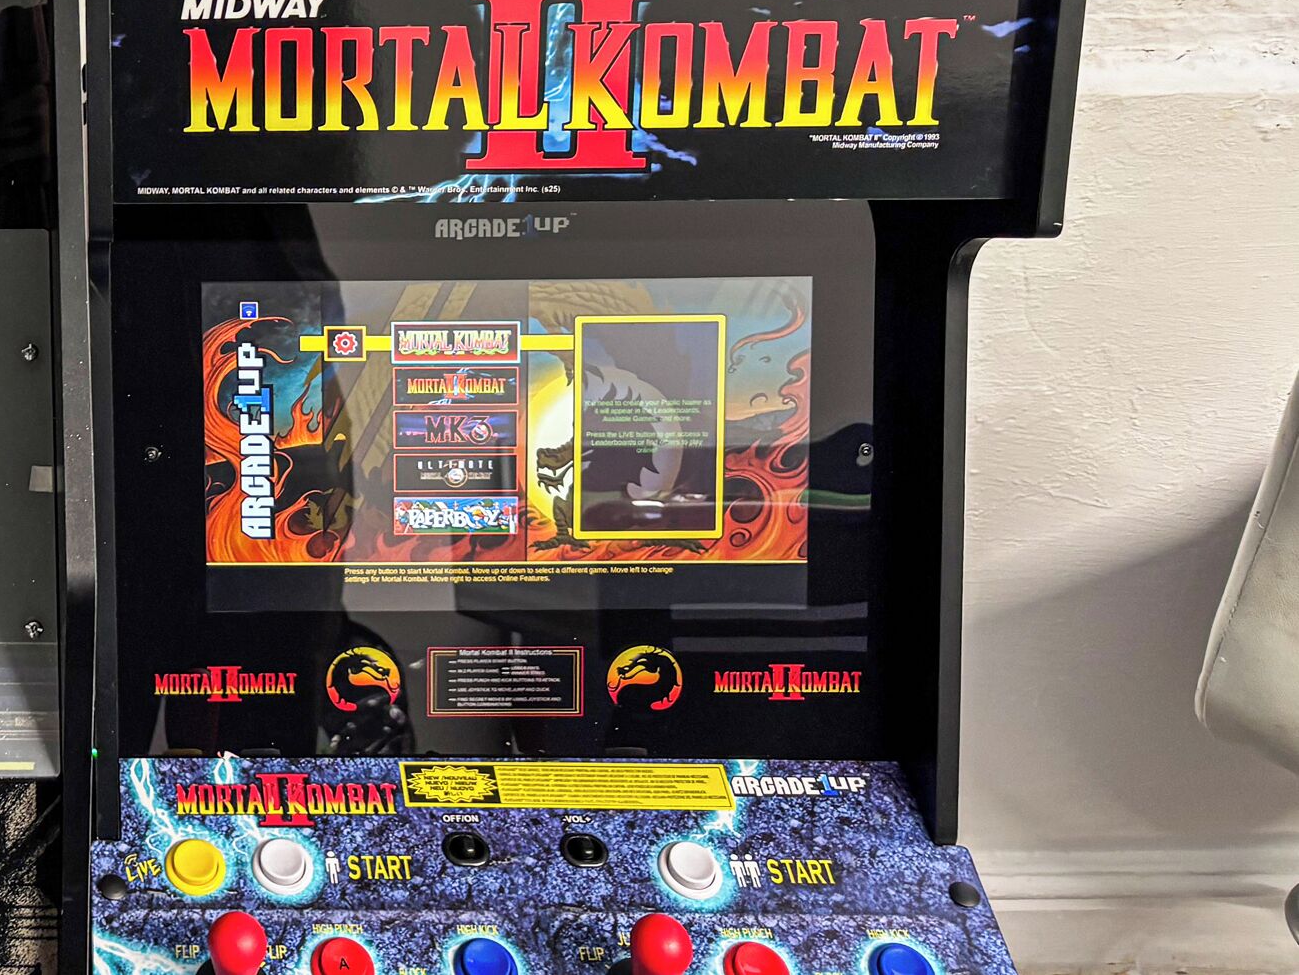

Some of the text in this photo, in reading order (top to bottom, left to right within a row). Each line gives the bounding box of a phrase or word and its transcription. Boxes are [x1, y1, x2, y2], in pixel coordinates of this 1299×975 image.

[182, 25, 549, 132] MORTAL
[832, 141, 939, 150] Midway Manufacturing Company
[843, 134, 873, 142] KOMBAT
[883, 133, 915, 144] Copyright
[137, 187, 171, 196] MIDWAY,
[207, 186, 241, 194] KOMBAT
[242, 186, 257, 194] and
[257, 186, 267, 194] all
[269, 186, 295, 194] related
[297, 186, 337, 194] characters
[339, 186, 353, 194] and
[355, 186, 389, 194] elements
[417, 186, 445, 194] Warner
[447, 186, 468, 194] Bros.
[398, 330, 511, 352] MORTAL KOMBAT
[407, 378, 455, 394] MORTAL
[456, 378, 506, 394] KOMBAT
[424, 416, 493, 445] MK3
[154, 674, 223, 695] MORTAL
[225, 673, 297, 694] KOMBAT
[713, 671, 785, 693] MORTAL
[787, 671, 862, 693] KOMBAT
[175, 783, 283, 815] MORTAL
[287, 783, 397, 815] KOMBAT
[442, 814, 479, 822] OFF/ON
[347, 855, 412, 881] START
[766, 858, 836, 884] START
[312, 924, 363, 934] HIGH PUNCH
[456, 925, 499, 935] HIGH KICK
[720, 927, 773, 938] HIGH PUNCH
[867, 928, 910, 939] HIGH KICK
[175, 944, 200, 959] FLIP
[267, 944, 288, 960] LIP
[579, 946, 604, 962] FLIP
[339, 958, 350, 970] A
